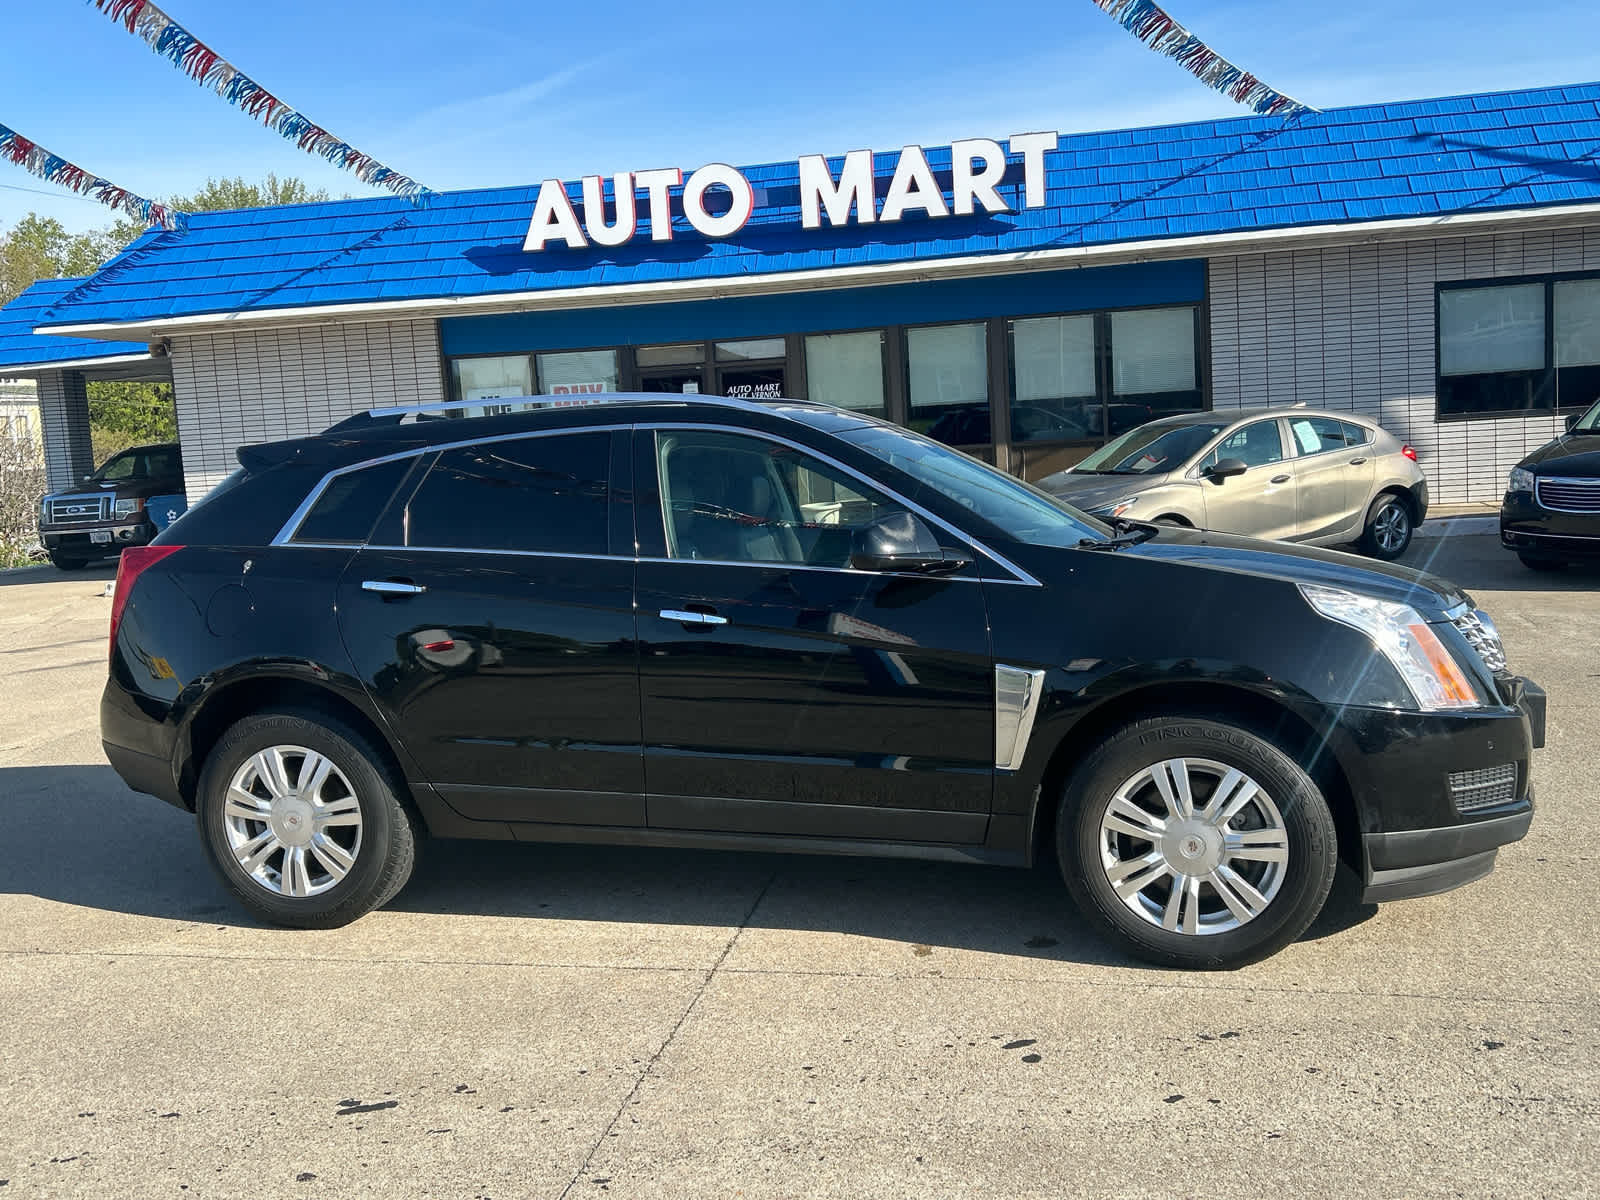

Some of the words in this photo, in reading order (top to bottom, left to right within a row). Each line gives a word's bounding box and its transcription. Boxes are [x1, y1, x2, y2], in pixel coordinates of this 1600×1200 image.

[522, 163, 753, 252] AUTO
[799, 131, 1058, 229] MART
[727, 384, 752, 394] AUTO
[754, 382, 781, 392] MART
[751, 390, 781, 398] VERNON
